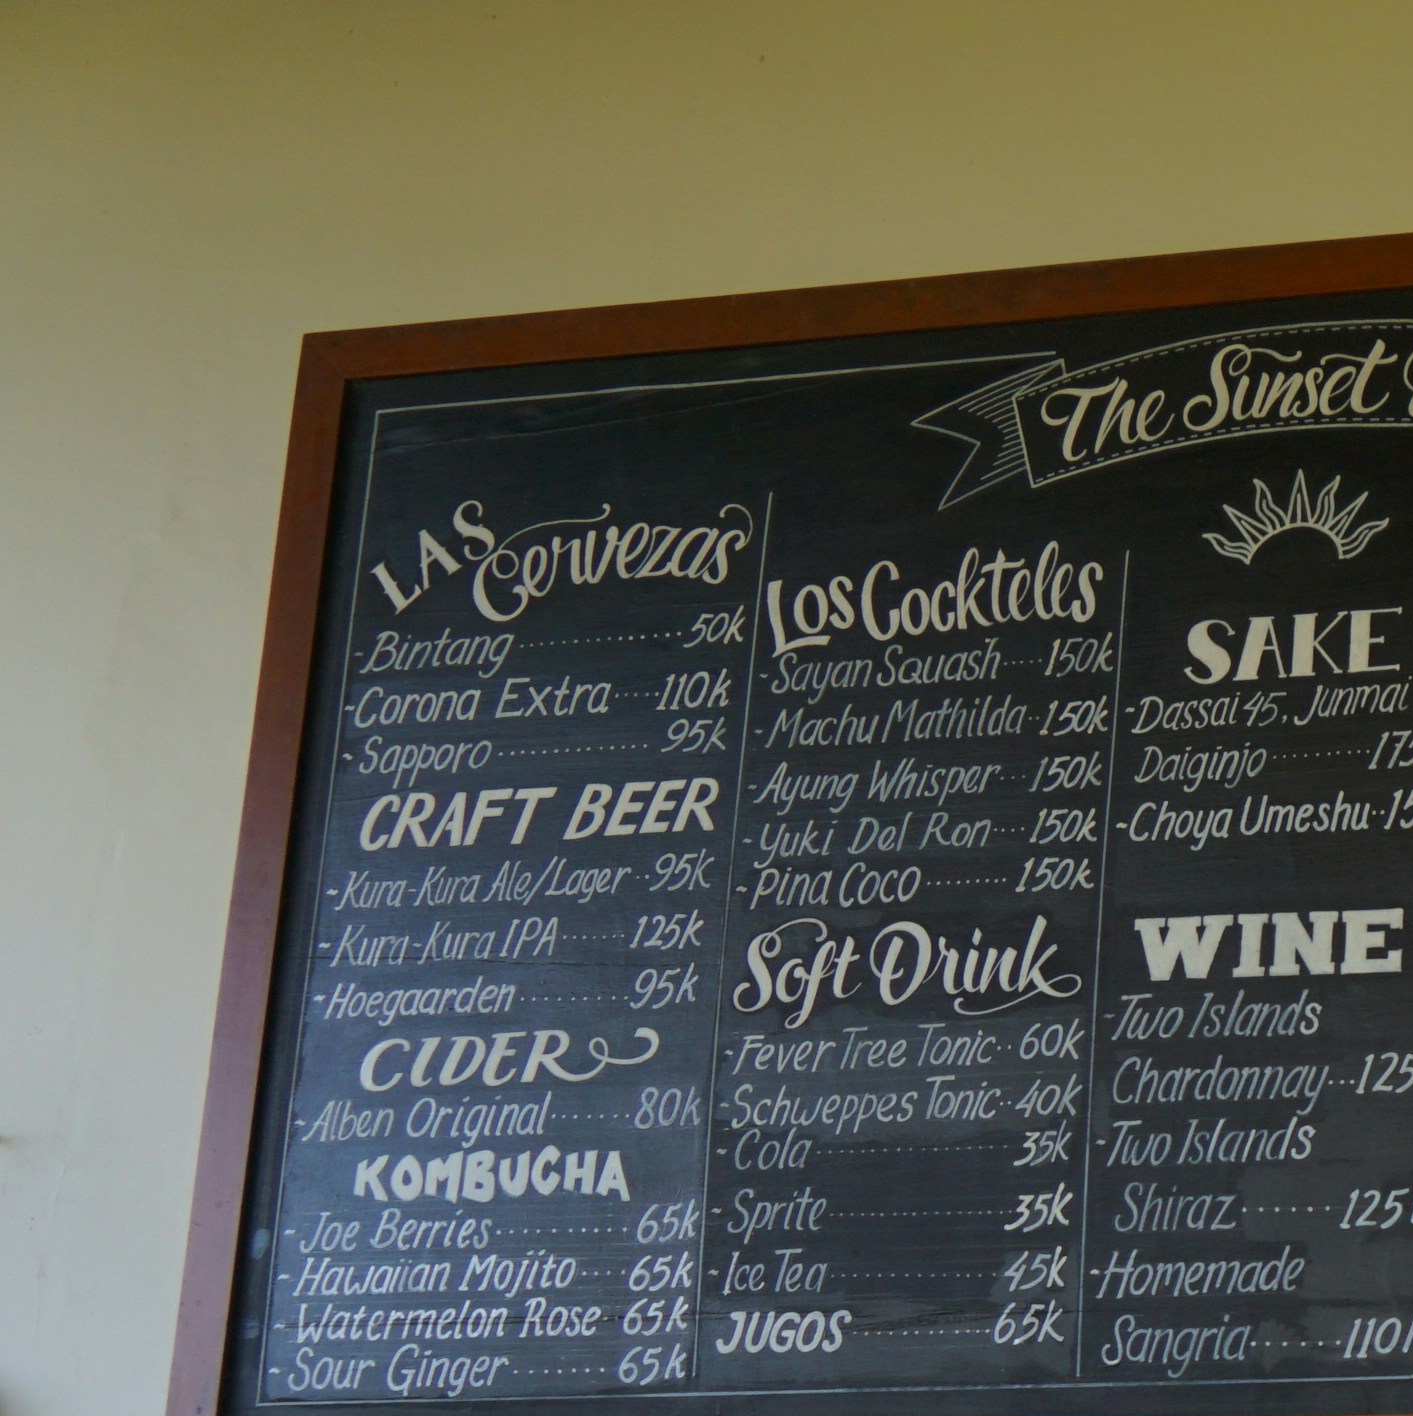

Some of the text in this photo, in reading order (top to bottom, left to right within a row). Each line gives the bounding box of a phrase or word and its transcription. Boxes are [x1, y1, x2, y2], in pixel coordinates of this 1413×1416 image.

[1041, 376, 1175, 463] The
[1182, 338, 1397, 432] Sunset
[369, 500, 754, 622] LAS Cervezas
[769, 541, 1104, 657] Los Cockteles
[359, 605, 745, 677] Bintang 50k
[769, 636, 1114, 703] Sayan Squash 150k
[1183, 607, 1403, 684] SAKE
[358, 719, 727, 788] Sapporo 95k
[359, 778, 722, 852] CRAFT BEER
[1129, 802, 1229, 850] Choya
[1240, 794, 1369, 837] Umeshu
[750, 859, 1096, 911] Pina Coco 150k
[329, 913, 704, 968] Kura-Kura IPA 125k
[733, 914, 1084, 1029] Soft Drink
[1134, 907, 1404, 982] WINE
[359, 1027, 659, 1092] CIDER
[301, 1087, 701, 1147] Alben Original 80k
[732, 1121, 1070, 1172] Cola 35k
[354, 1145, 631, 1202] KOMBUCHA
[1115, 1182, 1237, 1232] Shiraz
[458, 1249, 576, 1296] Mojito
[628, 1251, 694, 1290] 65k
[715, 1305, 1064, 1355] JUGOS 65k
[1101, 1315, 1251, 1378] Sangria
